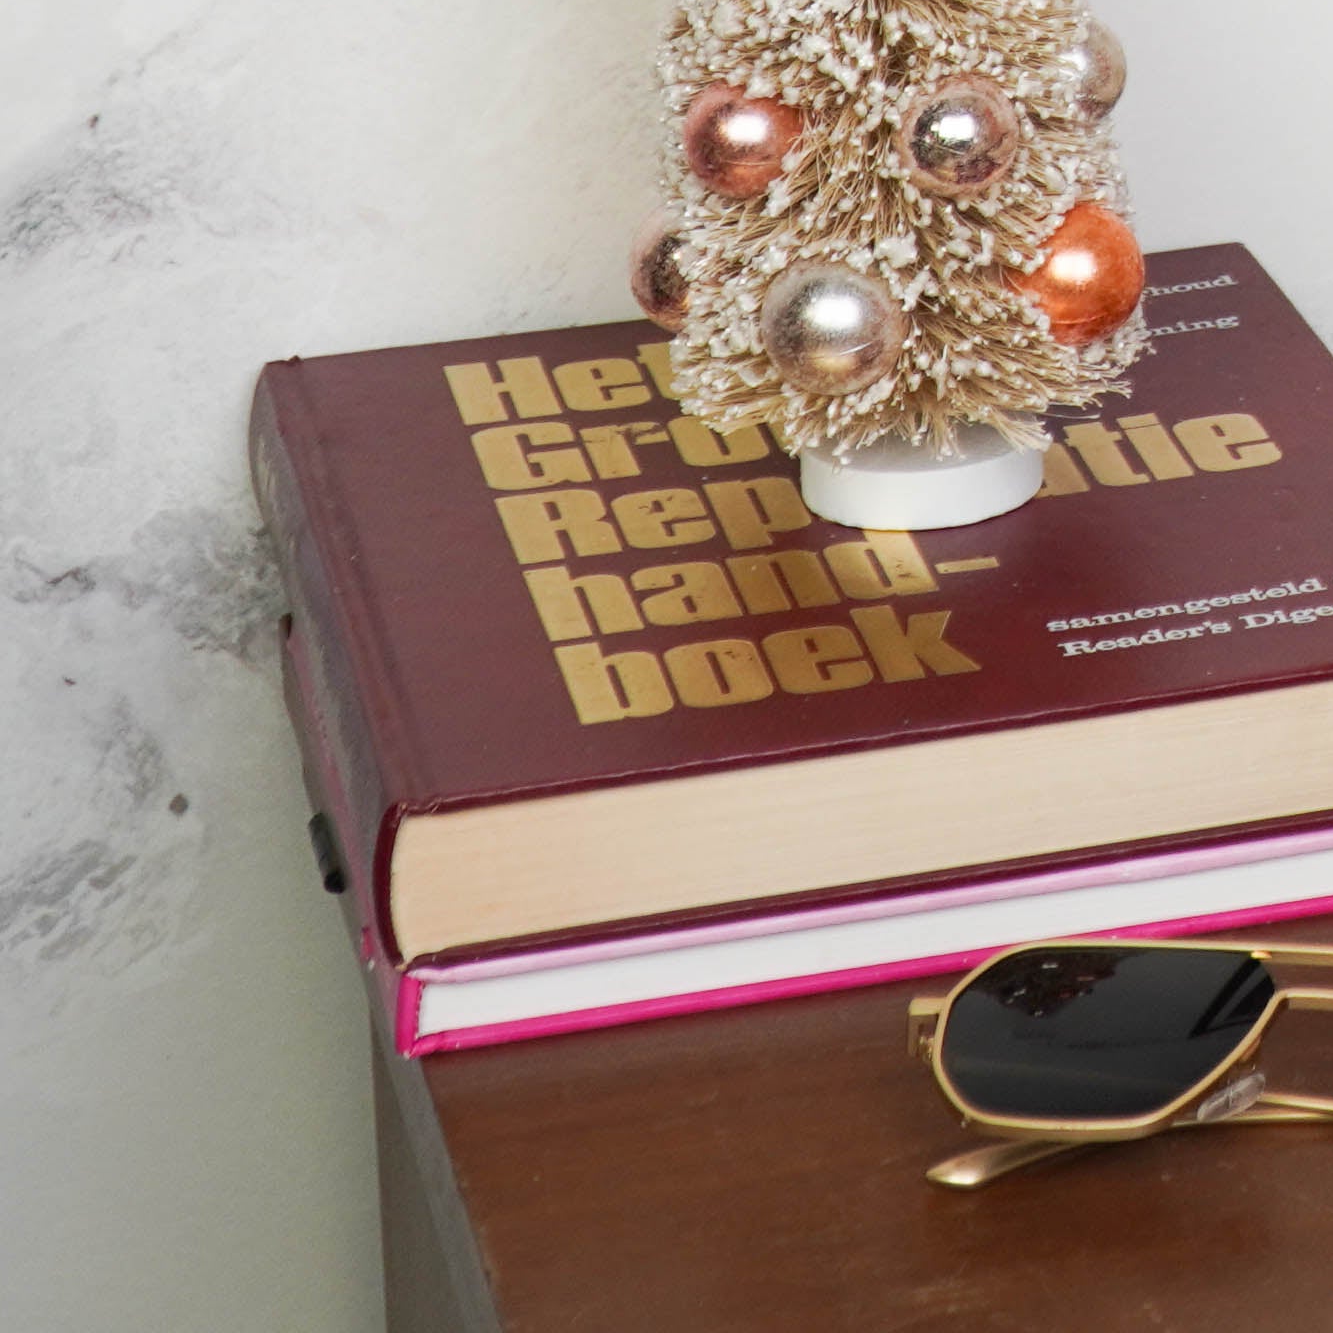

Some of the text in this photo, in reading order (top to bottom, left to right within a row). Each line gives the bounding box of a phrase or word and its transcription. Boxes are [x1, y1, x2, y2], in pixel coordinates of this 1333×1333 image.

[470, 415, 792, 491] Gro
[525, 529, 999, 641] hand-
[1046, 578, 1327, 632] samengesteld
[553, 605, 981, 726] boek
[1058, 620, 1232, 657] Reader's
